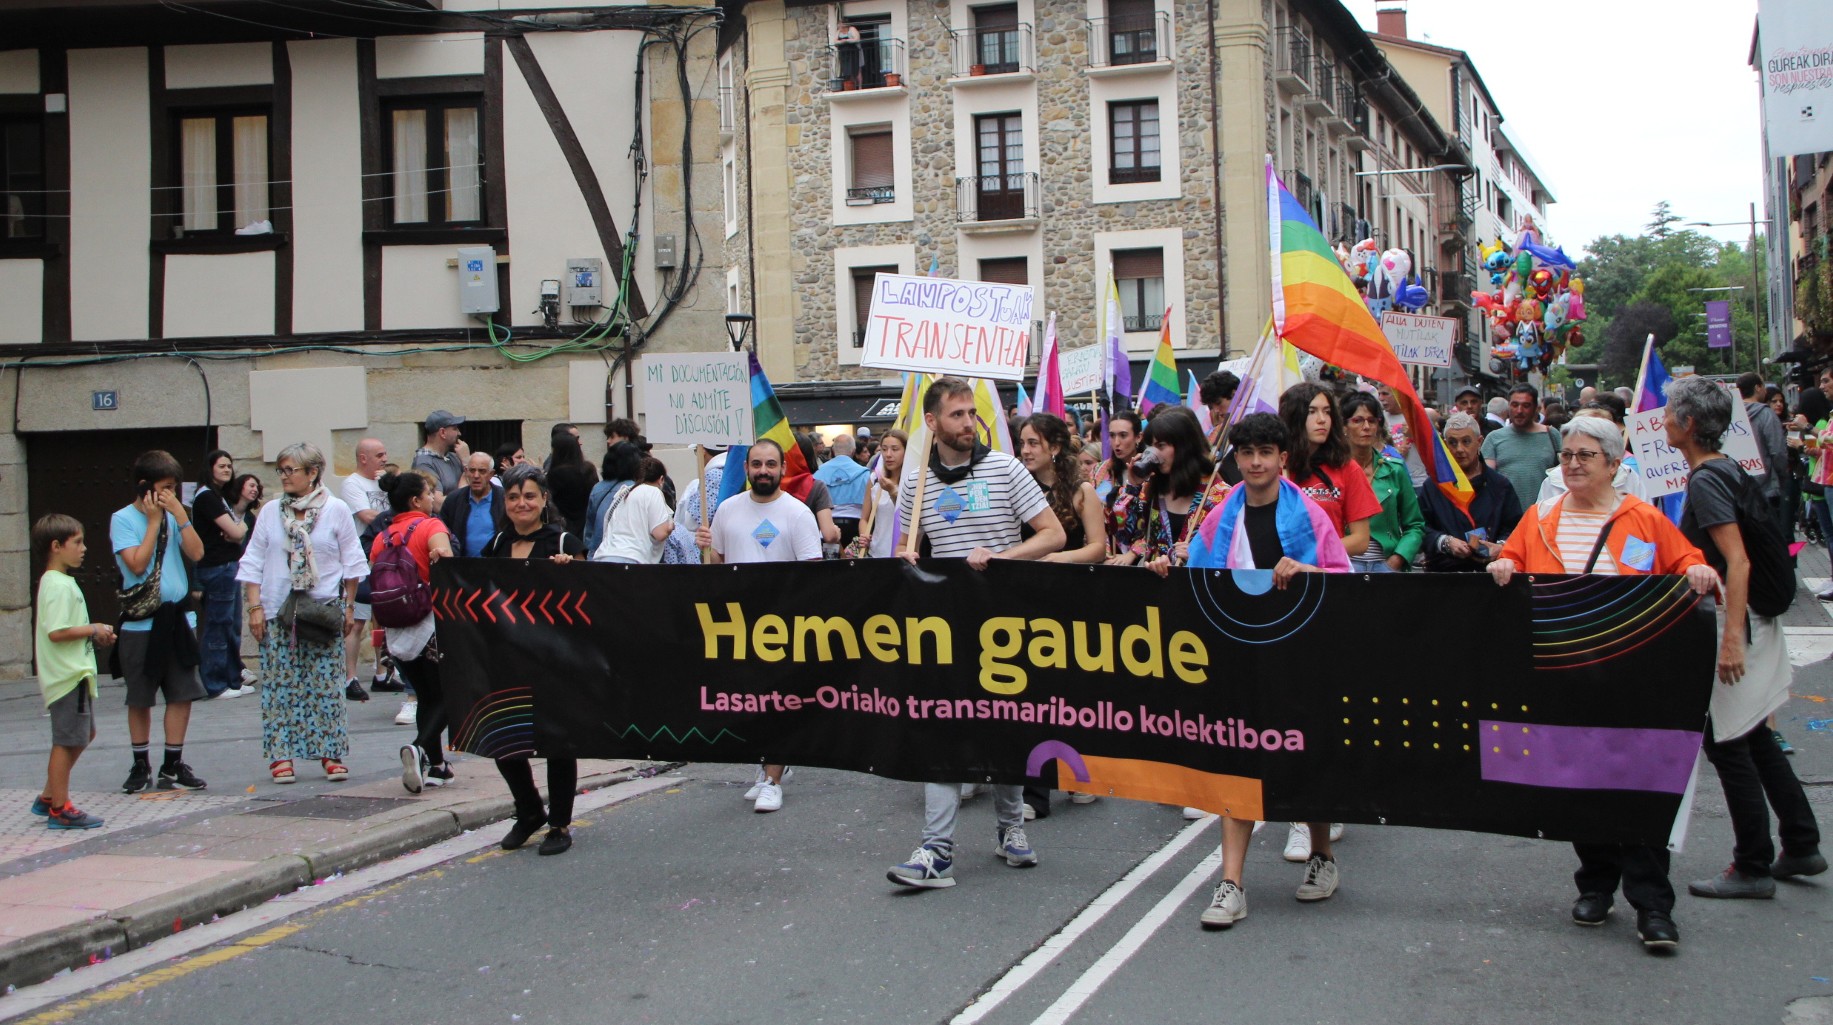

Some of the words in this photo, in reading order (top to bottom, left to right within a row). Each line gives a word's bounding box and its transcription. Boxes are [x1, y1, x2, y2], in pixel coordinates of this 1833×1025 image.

[1768, 54, 1811, 74] GUREAK
[1813, 51, 1833, 68] DIR
[1769, 73, 1788, 87] SON
[1790, 66, 1833, 84] NUESTRA
[1414, 317, 1445, 330] DUTEN
[98, 394, 112, 407] 16
[669, 393, 684, 409] NO
[695, 602, 953, 664] Hemen
[979, 606, 1209, 695] gaude
[700, 684, 900, 717] Lasarte-Oriako
[906, 695, 1134, 732] transmaribollo
[1140, 704, 1305, 751] kolektiboa
